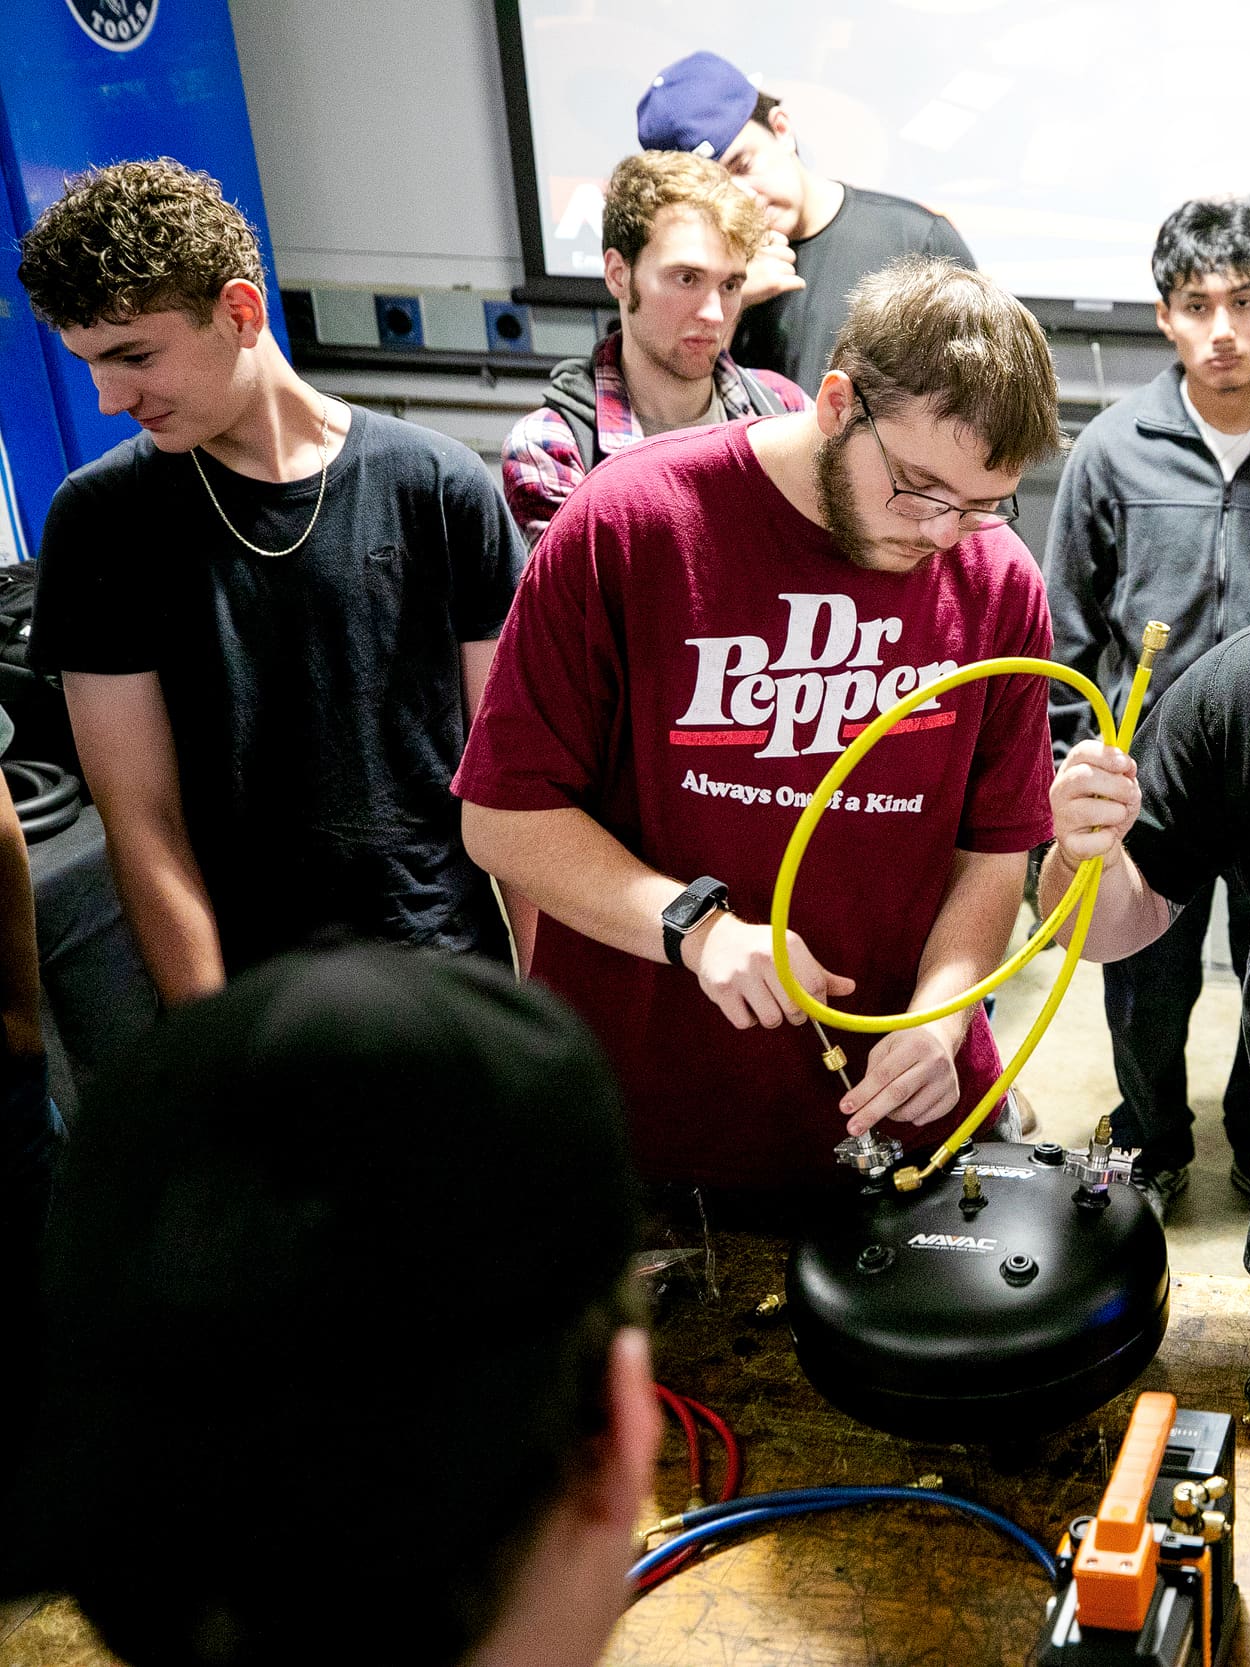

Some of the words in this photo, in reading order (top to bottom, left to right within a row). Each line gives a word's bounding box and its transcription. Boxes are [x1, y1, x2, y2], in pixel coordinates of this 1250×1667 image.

[91, 0, 148, 40] TOOLS
[768, 593, 903, 671] Dr
[681, 769, 772, 805] Always
[844, 796, 861, 812] a
[864, 793, 924, 814] Kind
[907, 1233, 998, 1251] NAVAC
